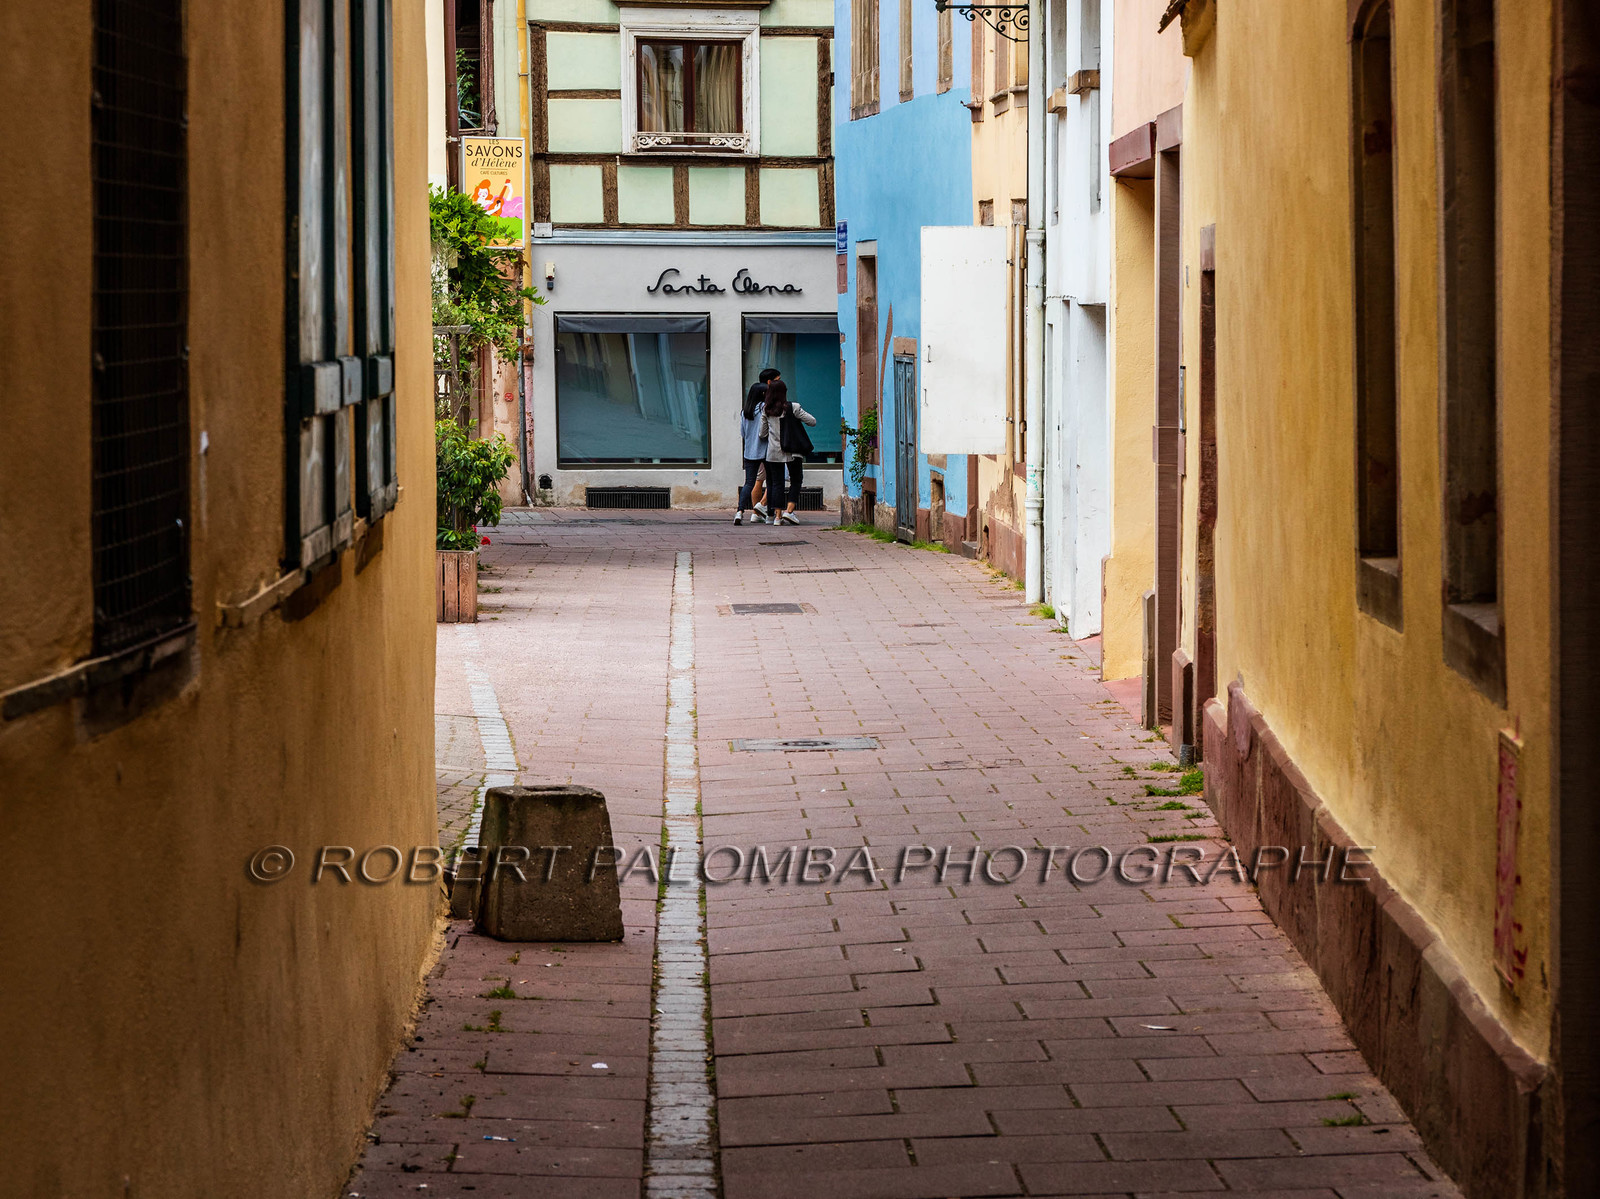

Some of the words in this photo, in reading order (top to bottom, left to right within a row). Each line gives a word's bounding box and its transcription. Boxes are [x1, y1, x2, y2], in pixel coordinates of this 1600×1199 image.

[466, 145, 523, 158] SAVONS
[647, 268, 726, 295] Santa
[732, 268, 803, 295] Elena
